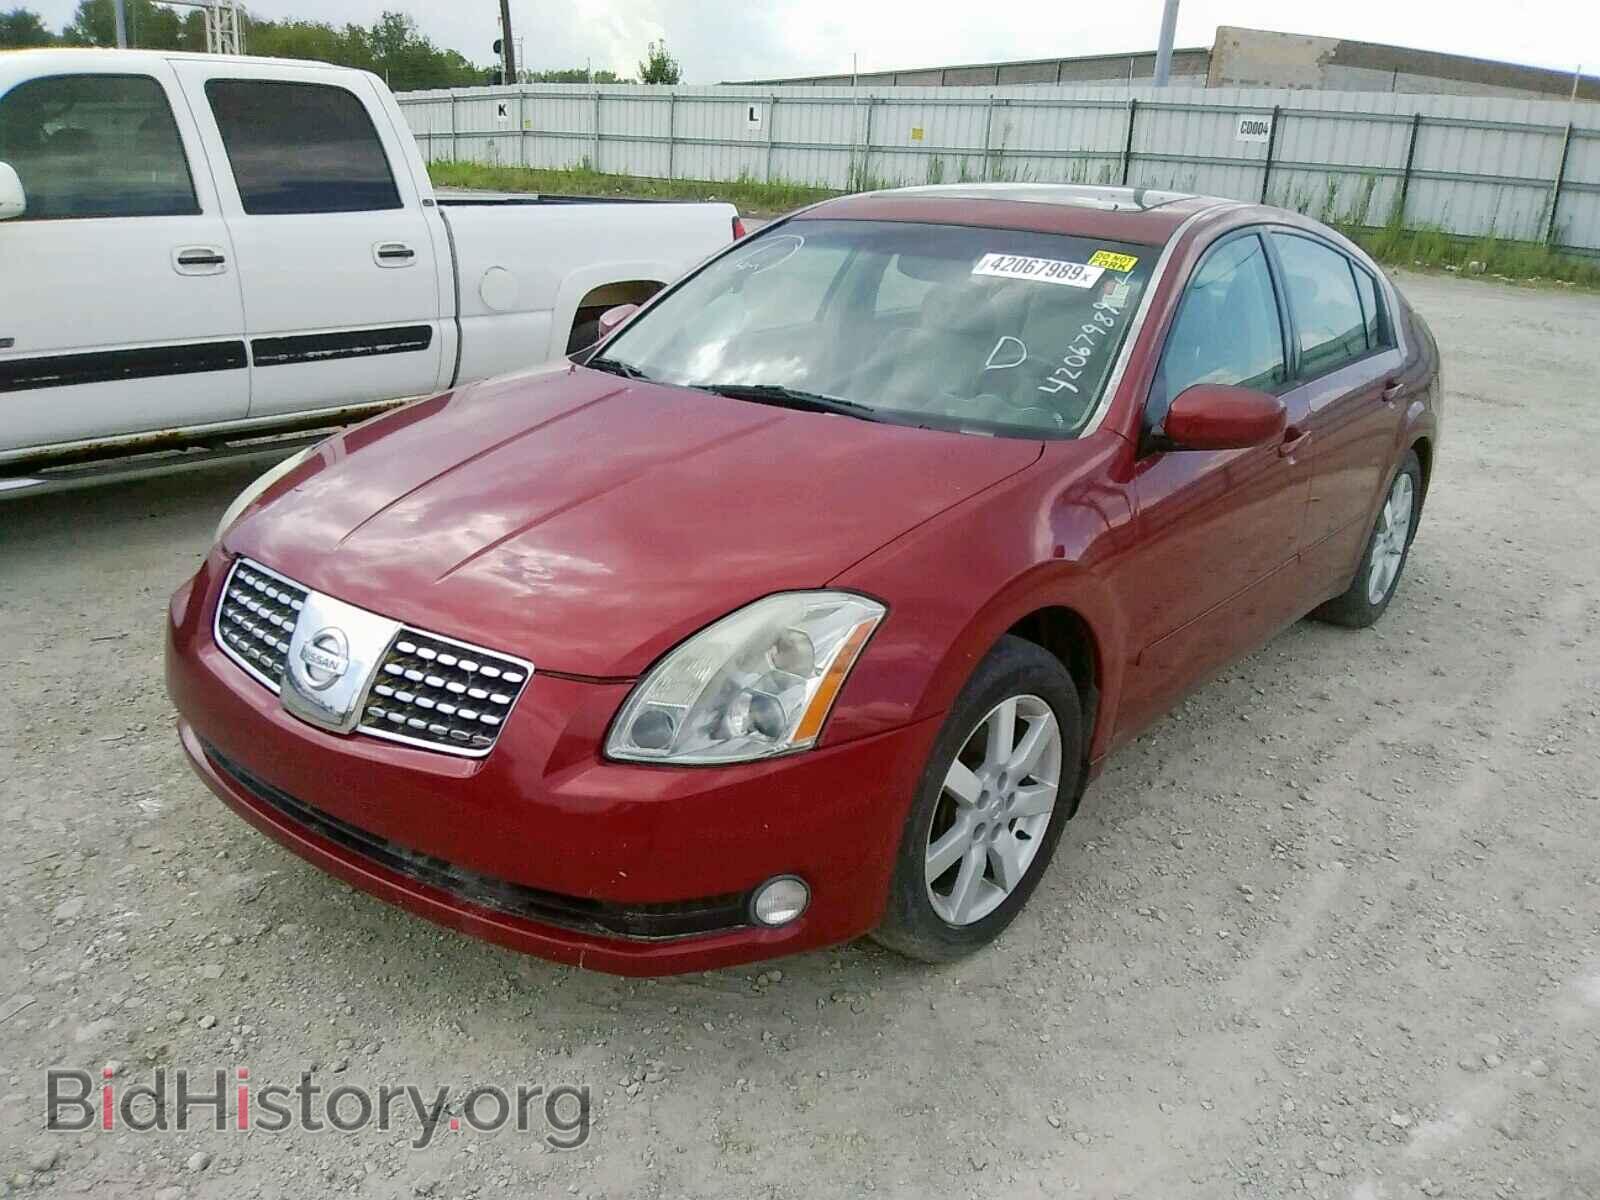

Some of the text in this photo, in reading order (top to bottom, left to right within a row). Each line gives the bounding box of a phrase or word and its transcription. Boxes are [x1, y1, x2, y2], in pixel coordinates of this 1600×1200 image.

[498, 103, 507, 117] K
[749, 106, 760, 121] L
[1037, 302, 1120, 393] 42067989
